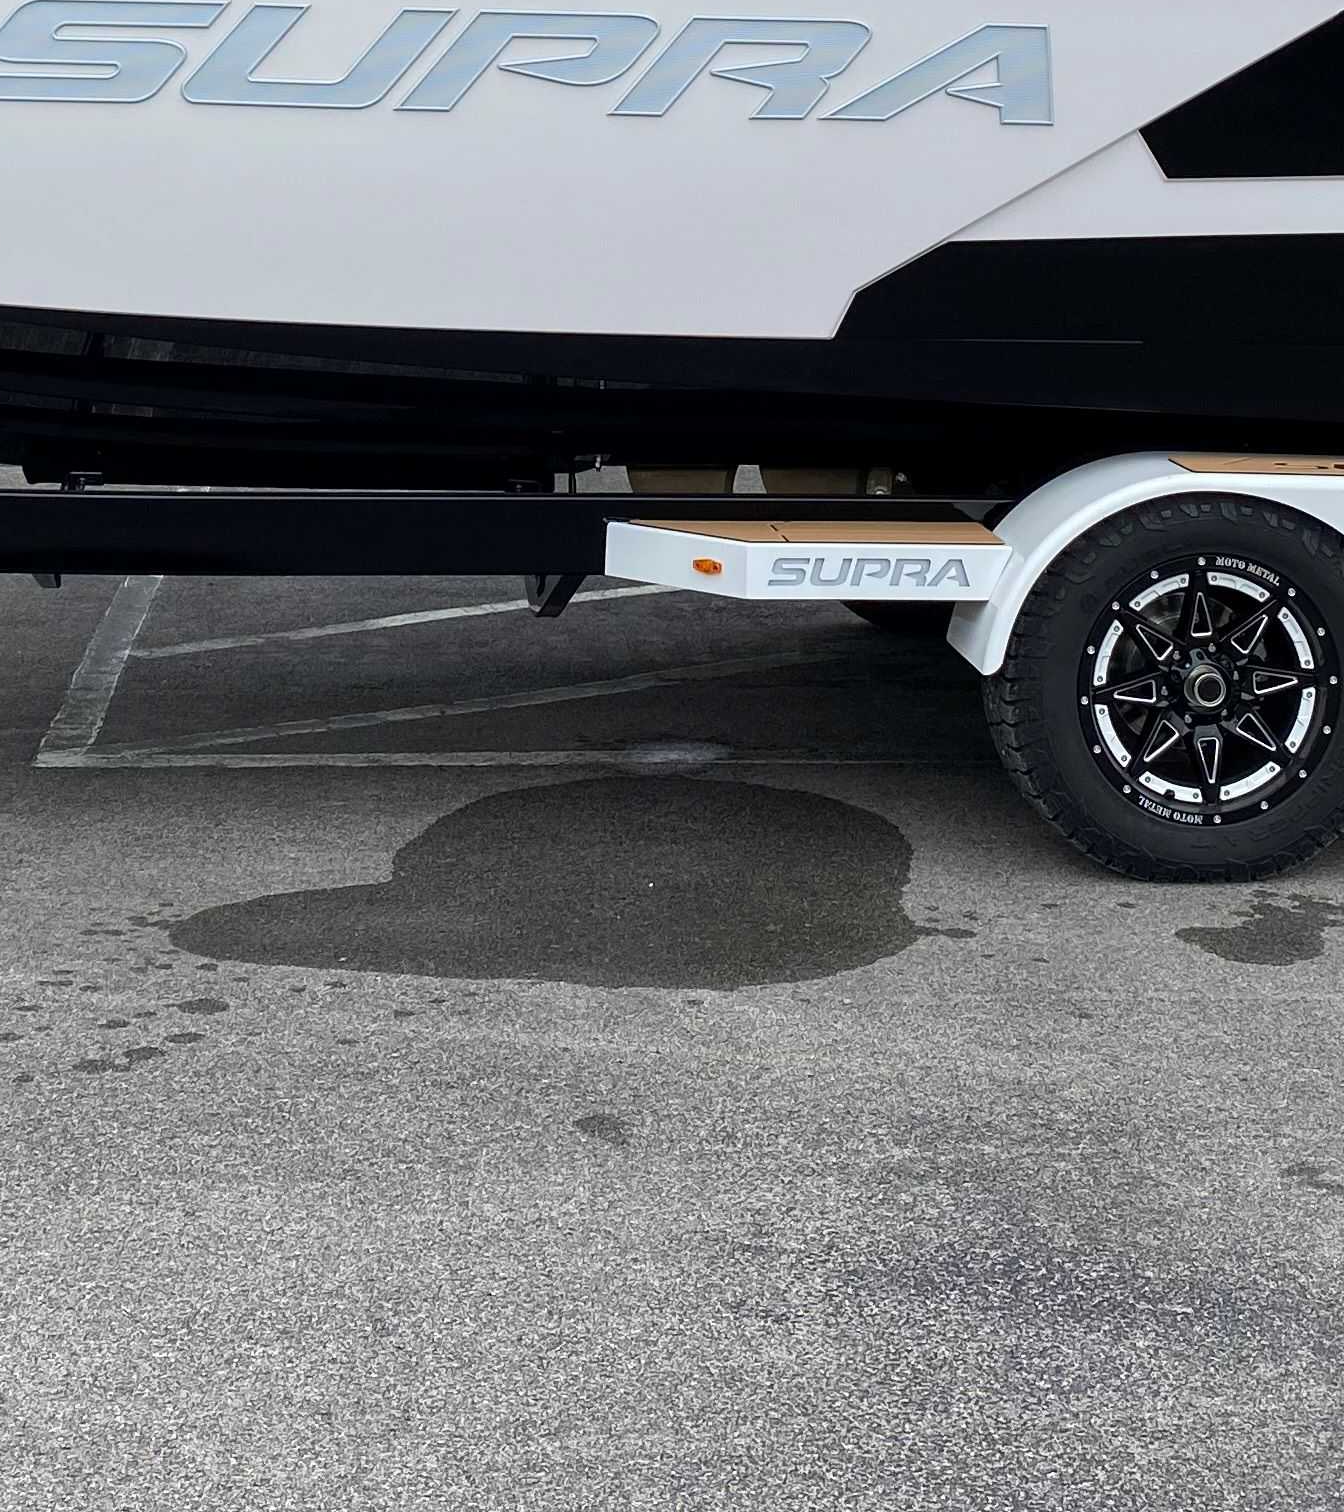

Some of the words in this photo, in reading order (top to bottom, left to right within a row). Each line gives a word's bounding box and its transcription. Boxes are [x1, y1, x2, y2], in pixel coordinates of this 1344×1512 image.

[767, 557, 971, 588] SUPRA
[1215, 556, 1246, 570] MOTO
[1247, 564, 1281, 586] METAL
[1138, 795, 1172, 820] METAL
[1173, 812, 1204, 825] MOTO
